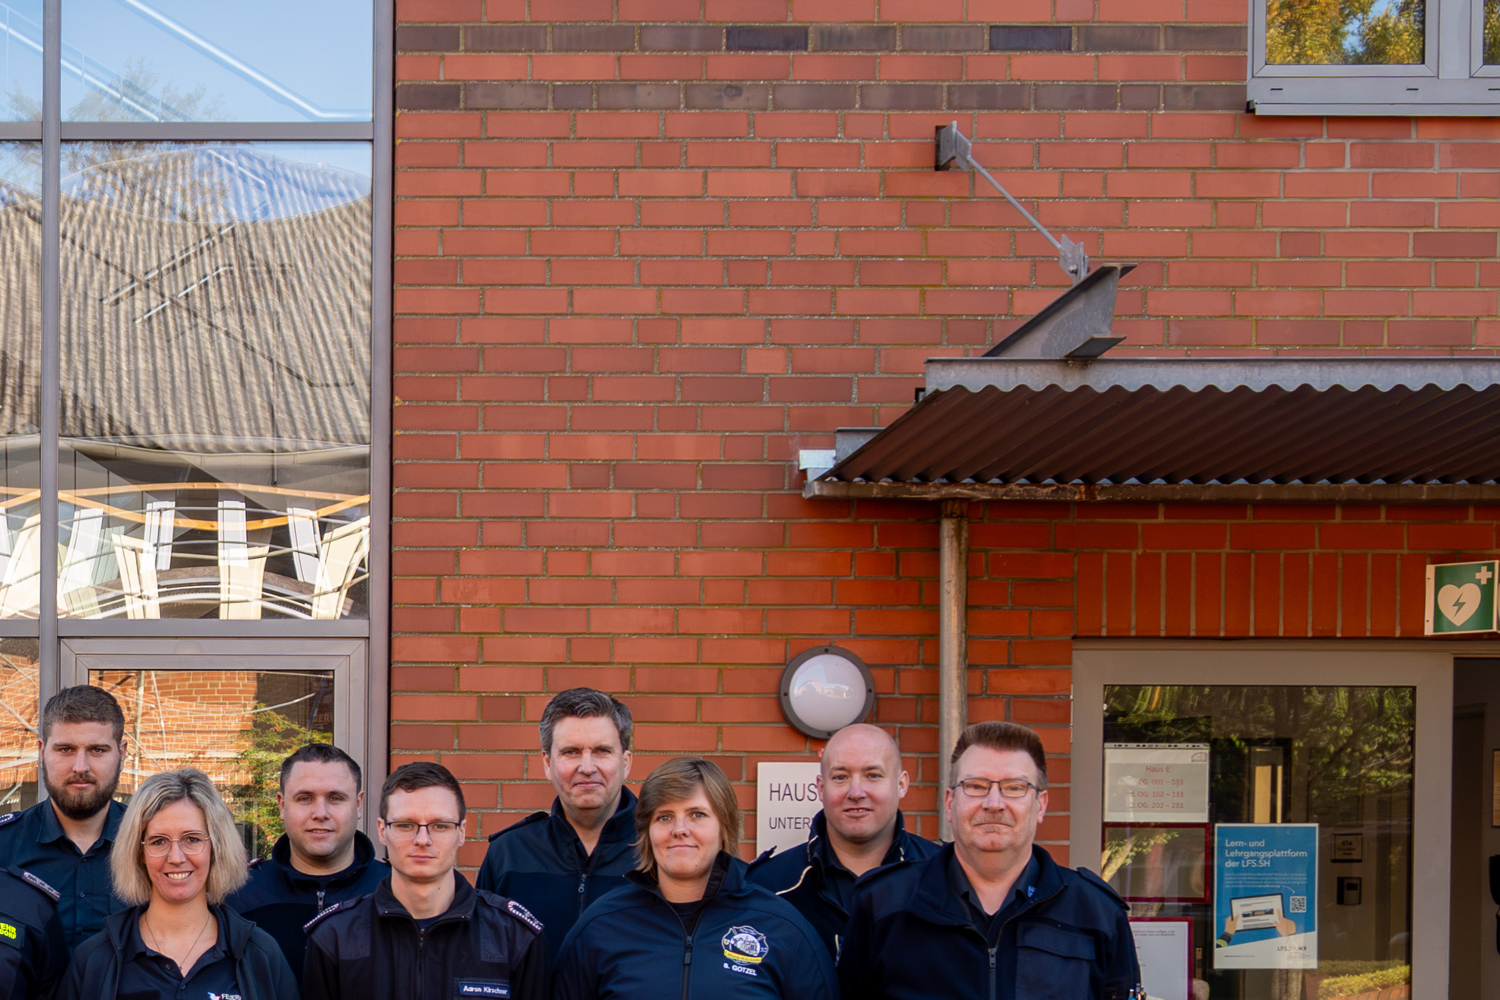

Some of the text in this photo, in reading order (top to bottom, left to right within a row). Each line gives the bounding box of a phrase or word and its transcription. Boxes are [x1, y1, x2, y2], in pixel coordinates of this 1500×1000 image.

[1145, 765, 1171, 773] Haus E
[769, 783, 818, 801] HAUS
[769, 817, 814, 829] UNTER
[1225, 839, 1265, 847] Lern- und
[1225, 849, 1308, 858] Lehrgangsplattform
